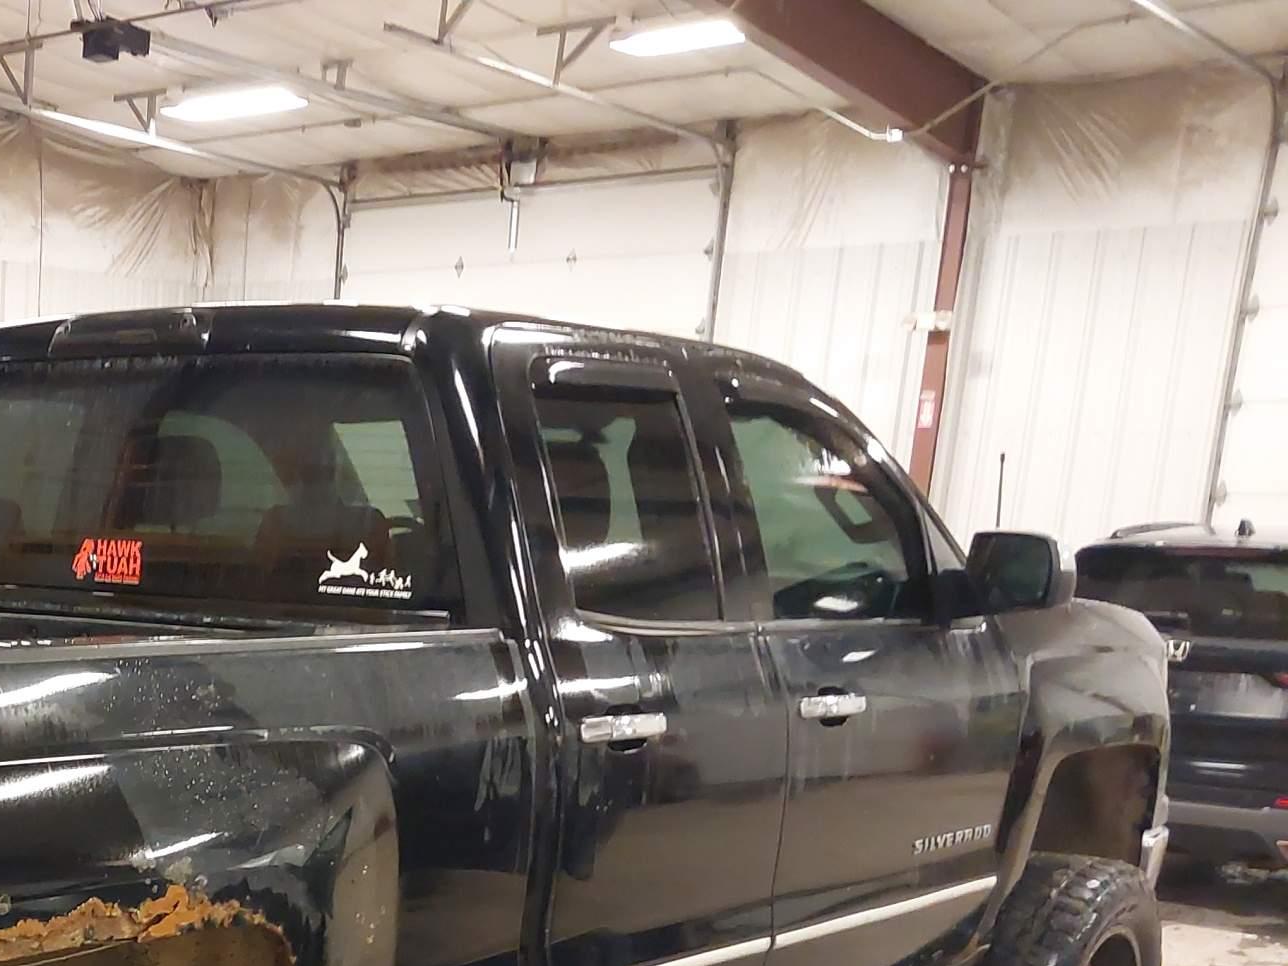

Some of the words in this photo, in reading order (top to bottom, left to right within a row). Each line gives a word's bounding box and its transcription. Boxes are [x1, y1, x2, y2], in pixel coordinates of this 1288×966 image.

[97, 539, 142, 558] HAWK
[95, 555, 141, 576] TUAH
[914, 823, 992, 855] SILVERADO
